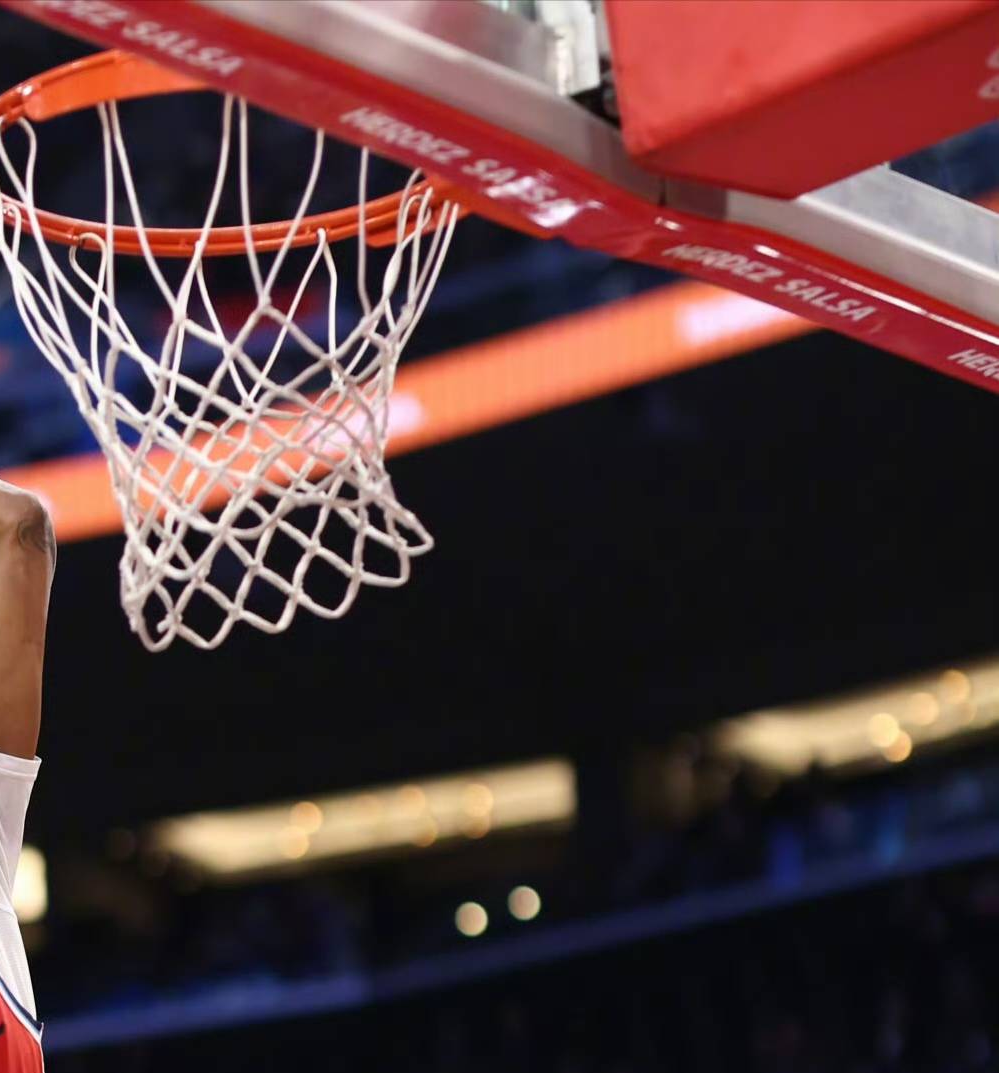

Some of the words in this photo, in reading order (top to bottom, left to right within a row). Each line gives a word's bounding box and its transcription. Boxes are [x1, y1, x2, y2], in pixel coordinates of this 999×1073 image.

[121, 20, 245, 76] SALSA
[338, 107, 472, 164] HERDEZ
[460, 158, 577, 220] SAS
[661, 243, 785, 283] HERDEZ
[773, 278, 877, 323] SALSA
[946, 348, 999, 381] HER
